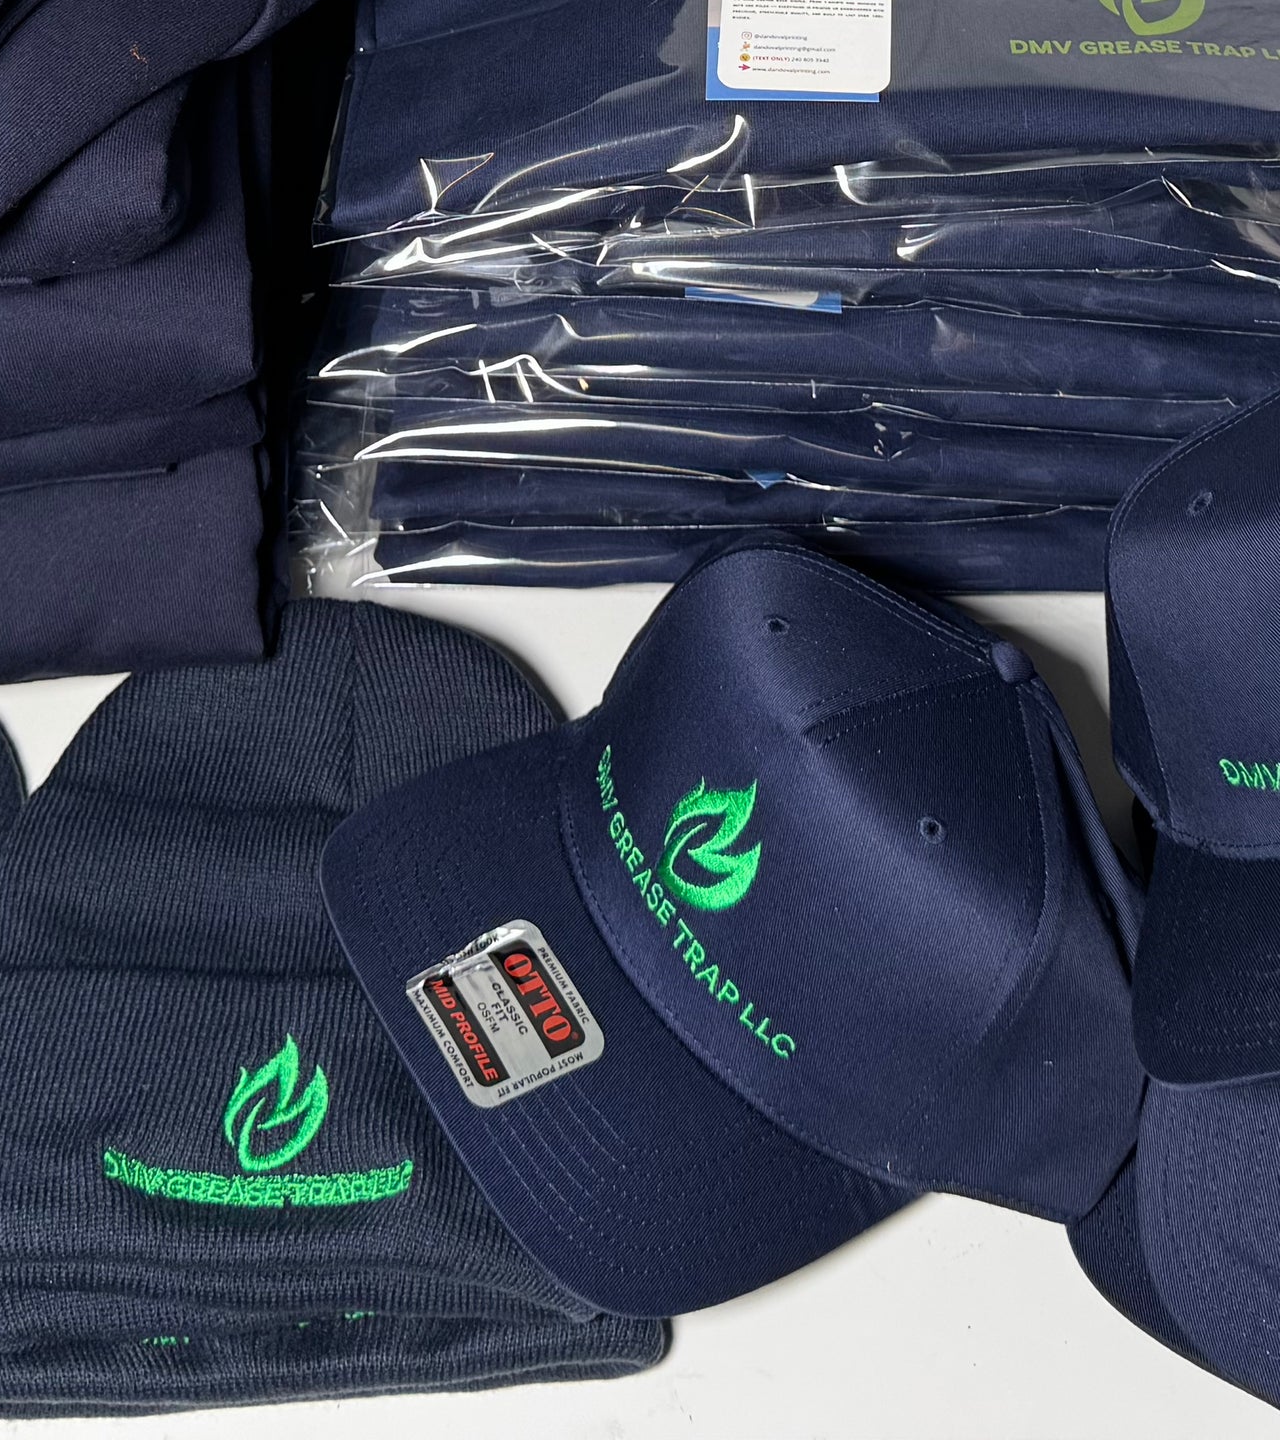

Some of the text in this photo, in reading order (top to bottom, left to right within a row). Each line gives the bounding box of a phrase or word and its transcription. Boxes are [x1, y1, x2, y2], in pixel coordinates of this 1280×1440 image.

[1009, 39, 1072, 54] DMV
[1079, 40, 1183, 55] GREASE
[1186, 41, 1256, 59] TRAP
[609, 811, 677, 927] GREASE
[673, 918, 741, 1005] TRAP
[739, 1002, 797, 1060] LLC
[477, 1001, 500, 1035] OSFM
[491, 982, 529, 1036] CLASSIC
[491, 1002, 509, 1023] FIT
[504, 953, 572, 1042] OTTO
[537, 946, 590, 1025] PREMIUM FABRIC
[412, 989, 474, 1088] MAXIMUM COMFORT
[430, 979, 457, 1009] MID
[450, 1011, 499, 1082] PROFILE
[497, 1051, 584, 1098] MOST POPULAR FIT
